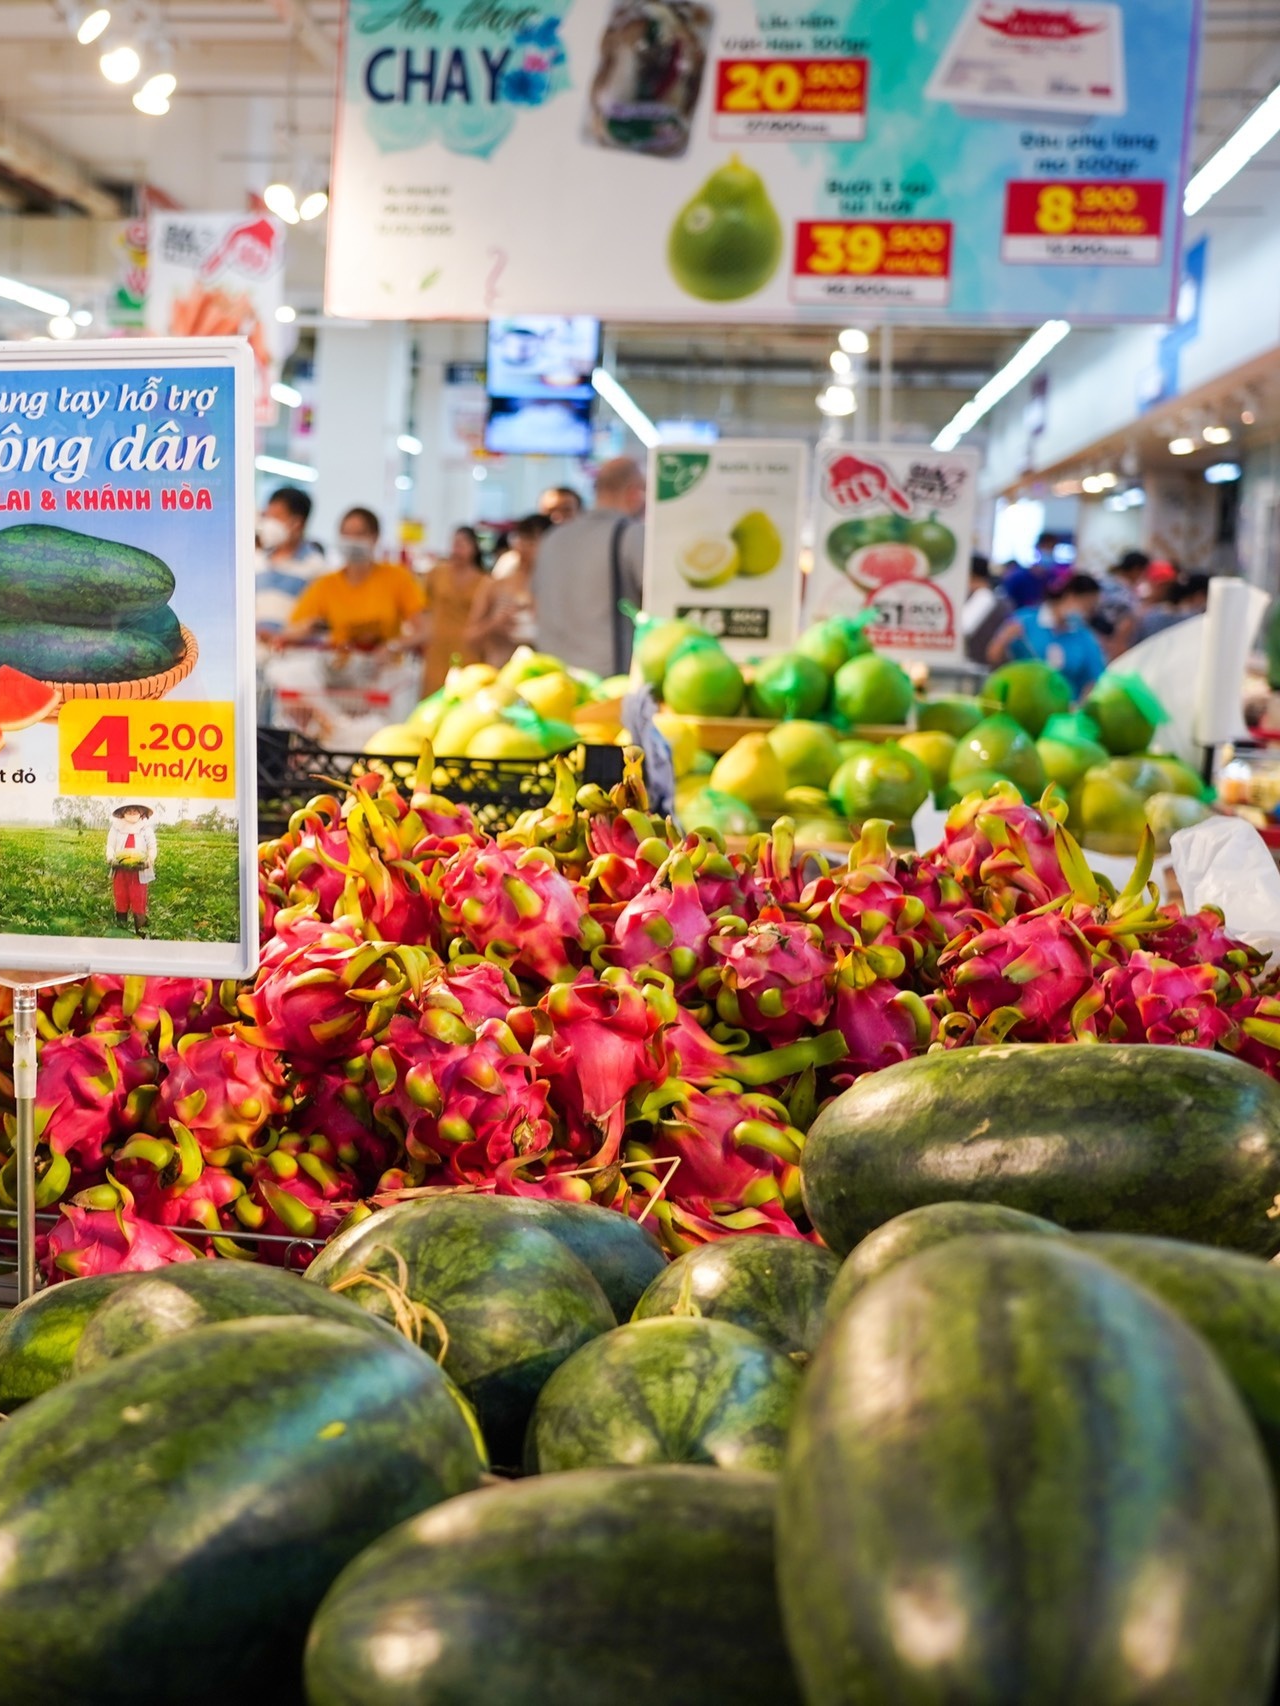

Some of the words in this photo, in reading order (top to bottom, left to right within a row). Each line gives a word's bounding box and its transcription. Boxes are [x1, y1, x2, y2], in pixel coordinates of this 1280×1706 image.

[366, 46, 511, 104] CHAY
[722, 62, 803, 111] 20
[1035, 184, 1077, 234] 8
[806, 224, 884, 274] 39
[58, 385, 109, 419] tay
[117, 375, 163, 414] hỗ
[168, 383, 219, 419] trợ
[110, 420, 220, 472] dân
[40, 490, 57, 511] &
[65, 482, 152, 511] KHÁNH
[161, 482, 213, 511] HÒA
[70, 715, 138, 784] 4
[139, 723, 223, 751] .200
[138, 757, 228, 783] vnd/kg
[12, 766, 37, 784] đỏ
